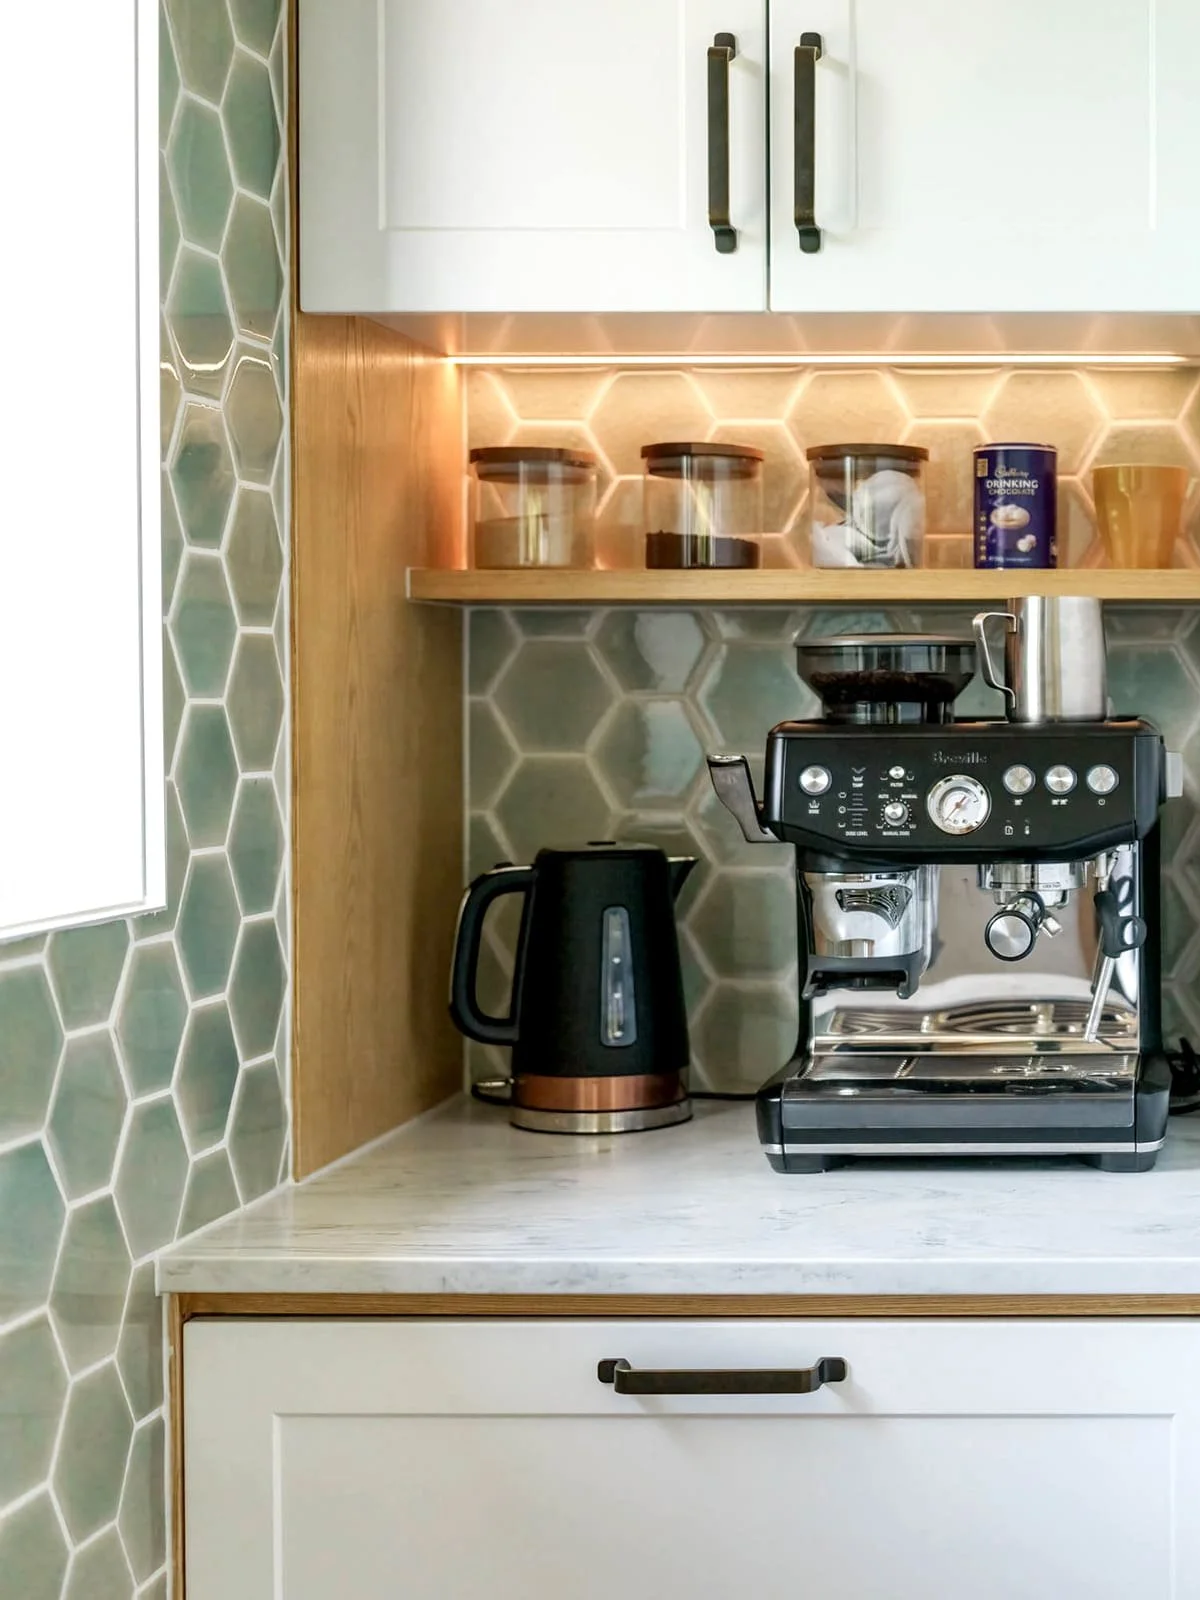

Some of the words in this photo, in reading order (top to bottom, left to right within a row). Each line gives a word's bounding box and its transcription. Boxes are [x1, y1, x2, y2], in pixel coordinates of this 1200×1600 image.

[986, 479, 1039, 489] DRINKING
[988, 488, 1036, 497] CHOCOLATE
[932, 750, 988, 764] Breville
